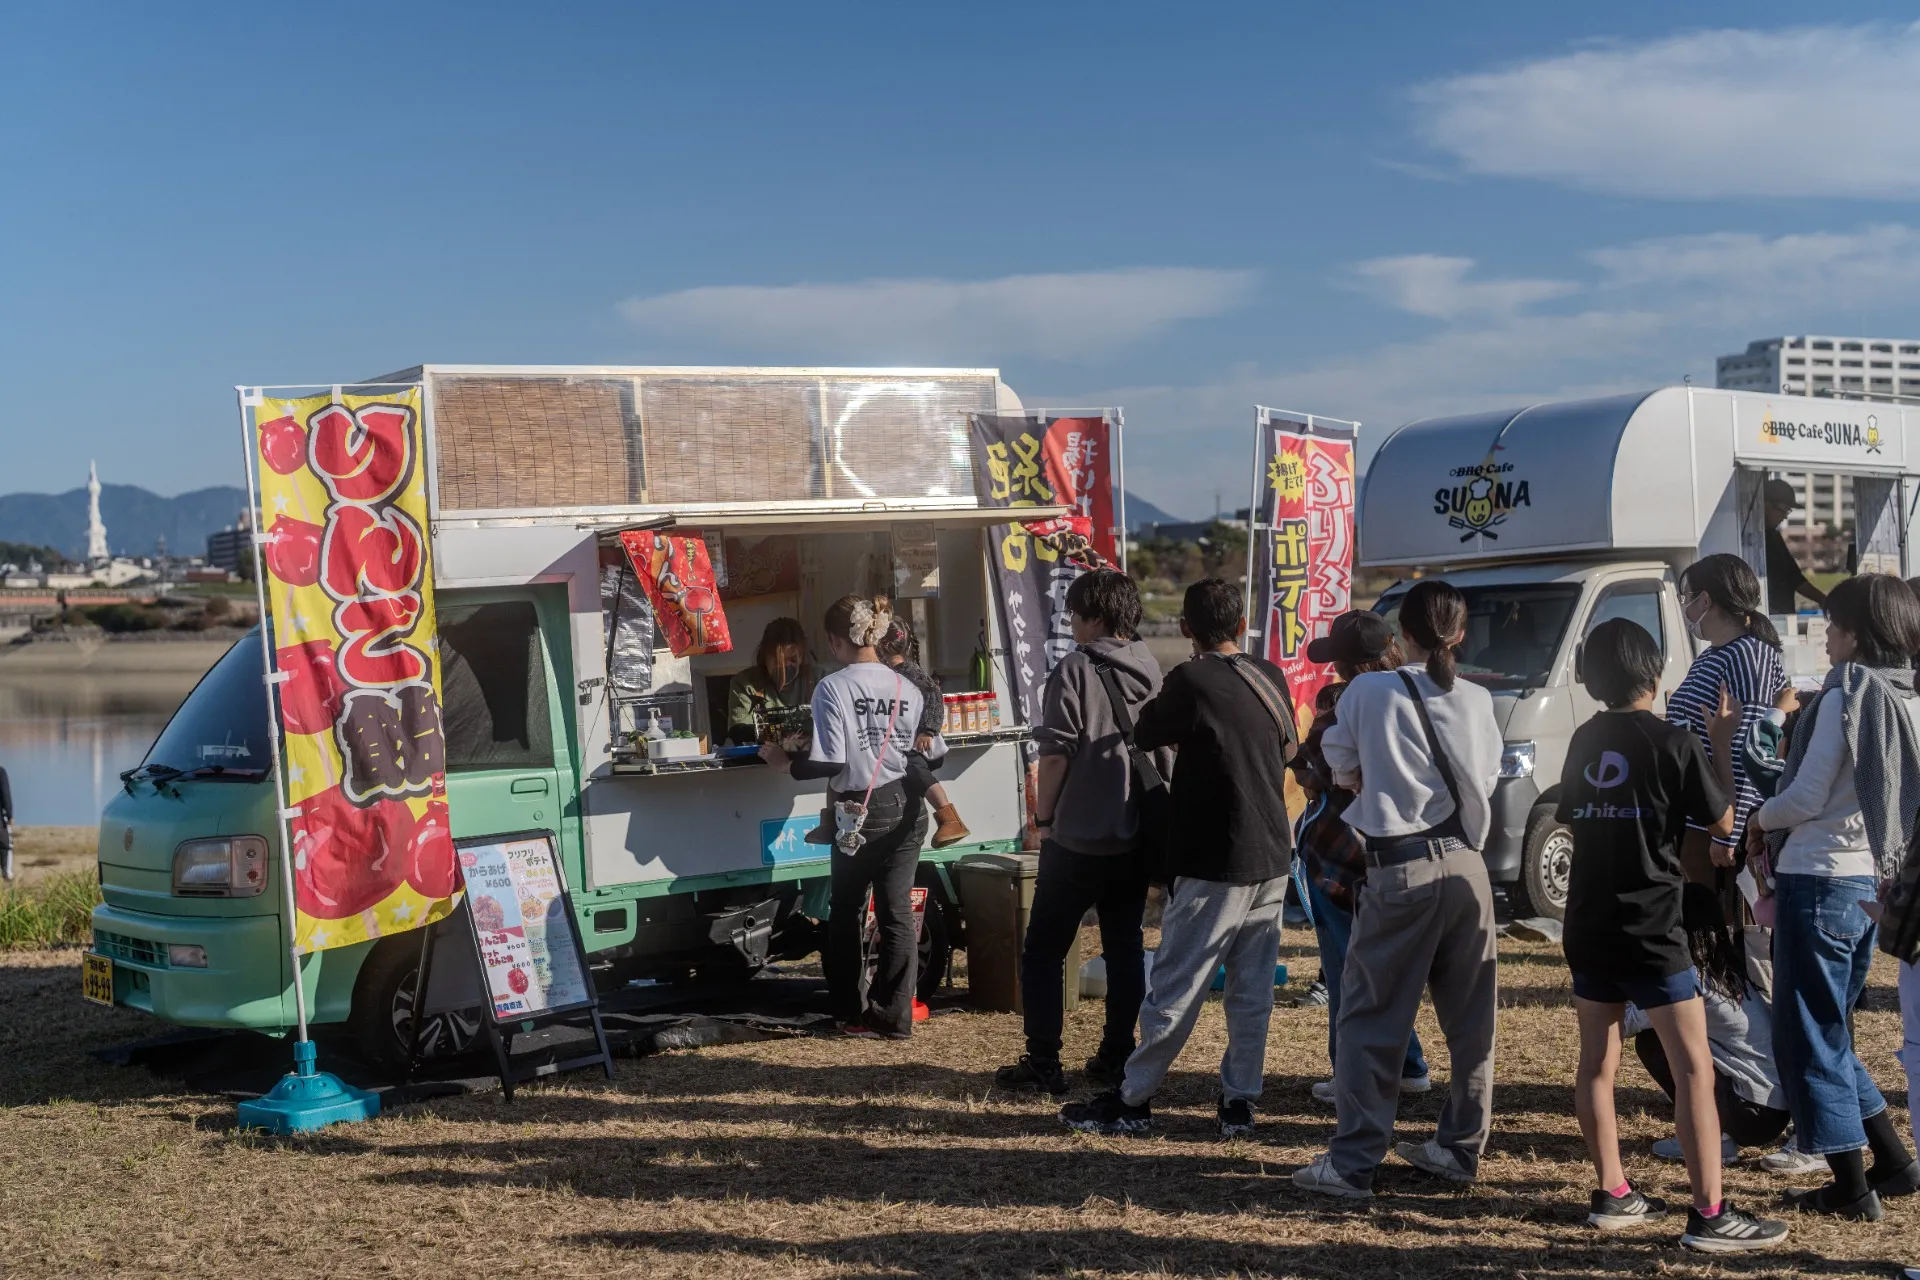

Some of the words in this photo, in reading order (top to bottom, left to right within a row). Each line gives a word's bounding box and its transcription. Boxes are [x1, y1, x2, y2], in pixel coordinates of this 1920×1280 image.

[1768, 421, 1796, 440] BBQ
[1798, 422, 1823, 440] Cafe
[1824, 421, 1861, 447] SUNA
[1276, 461, 1298, 478] 揚げ
[1486, 462, 1515, 474] Cafe
[1272, 521, 1308, 656] ポテト
[309, 405, 445, 804] りんご飴
[854, 697, 909, 717] STAFF
[468, 862, 507, 878] からあげ
[485, 877, 511, 888] ¥600
